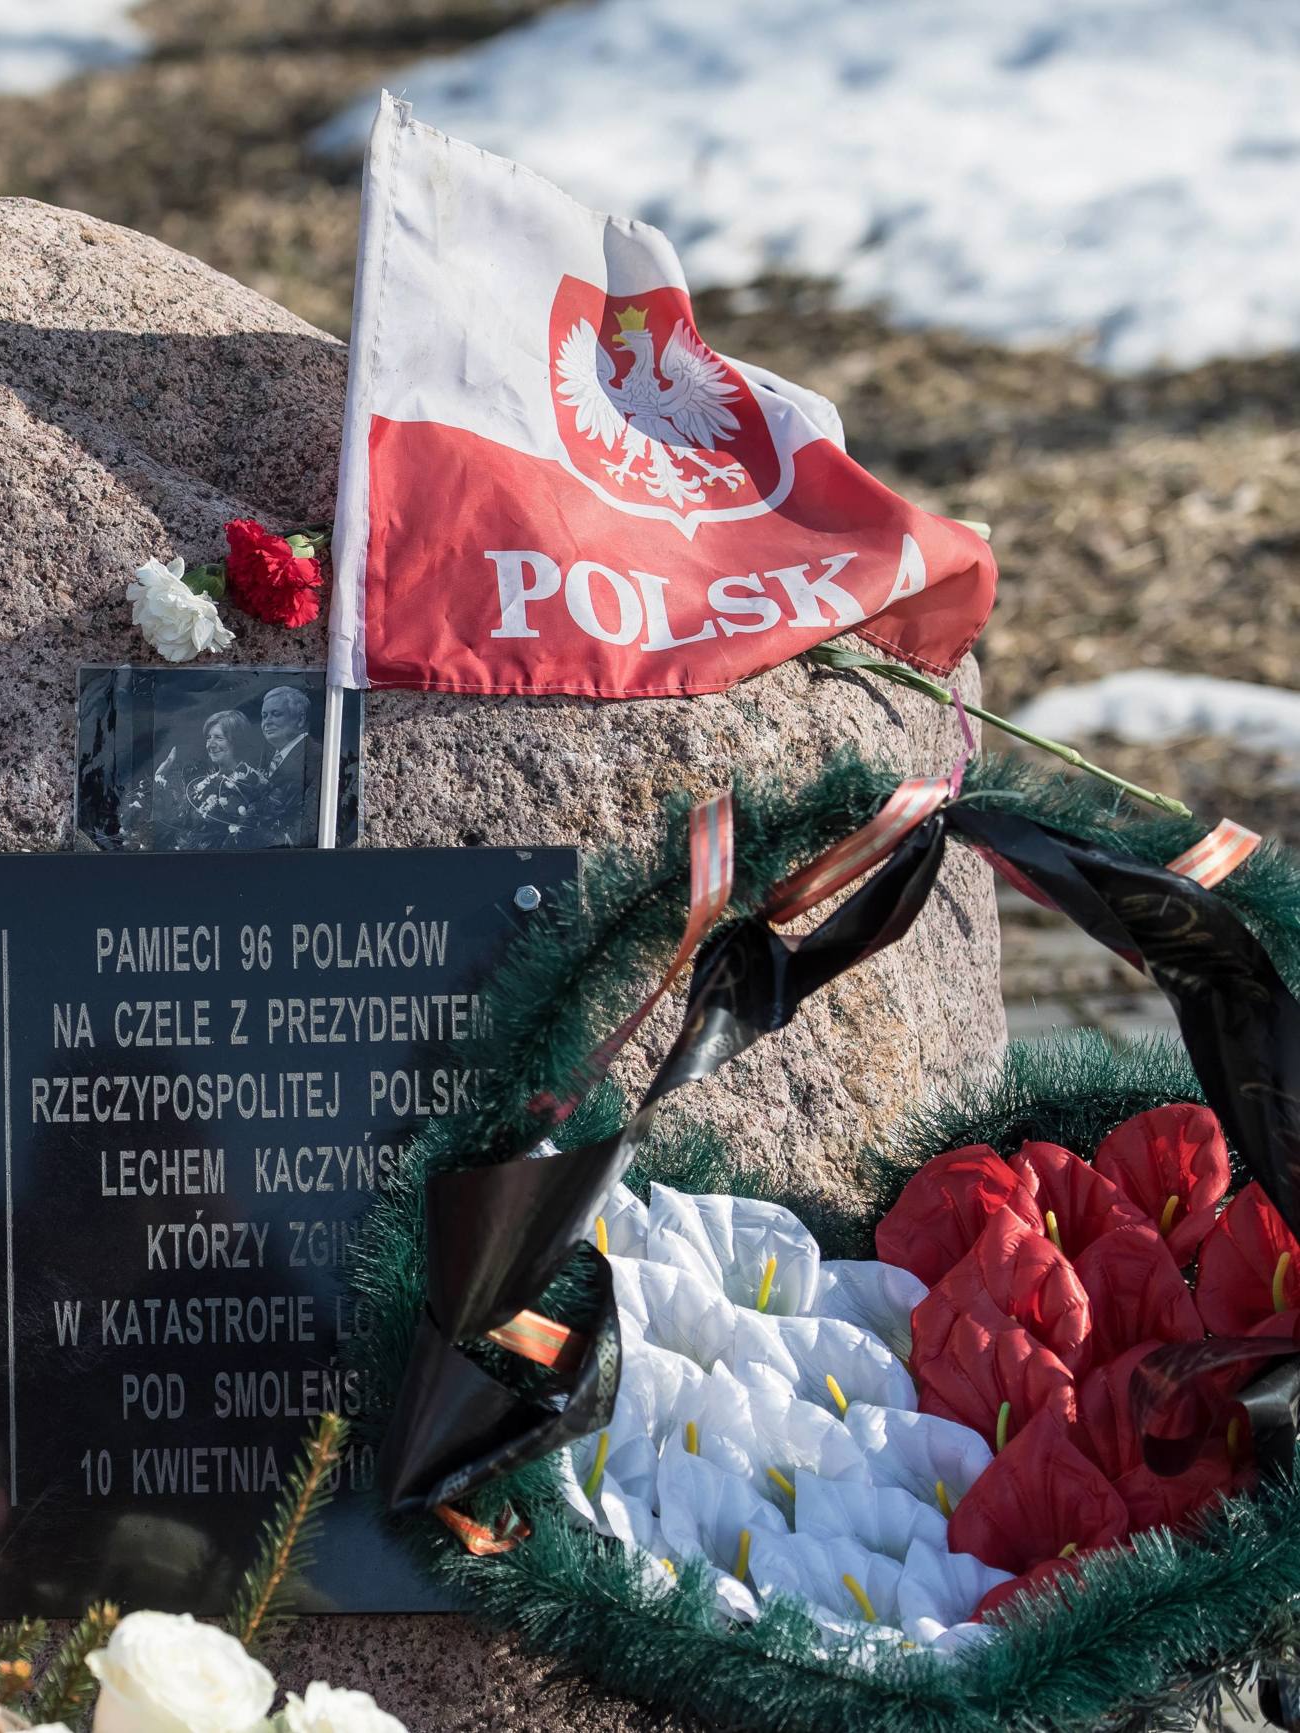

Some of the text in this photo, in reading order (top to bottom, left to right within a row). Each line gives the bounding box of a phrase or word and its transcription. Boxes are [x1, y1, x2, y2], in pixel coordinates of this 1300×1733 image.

[483, 533, 927, 652] POLSKA
[96, 905, 450, 974] PAMIECI 96 POLAKÓW
[53, 993, 495, 1049] NA CZELE Z PREZYDENTEM
[31, 1068, 496, 1124] RZECZYPOSPOLITEJ POLSKI
[101, 1132, 414, 1197] LECHEM KACZYŃS
[147, 1210, 270, 1270] KTÓRZY
[53, 1300, 82, 1347] W
[101, 1295, 316, 1347] KATASTROFIE
[122, 1356, 370, 1420] POD SMOLEŃS
[80, 1444, 375, 1497] 10 KWIETNIA 010
